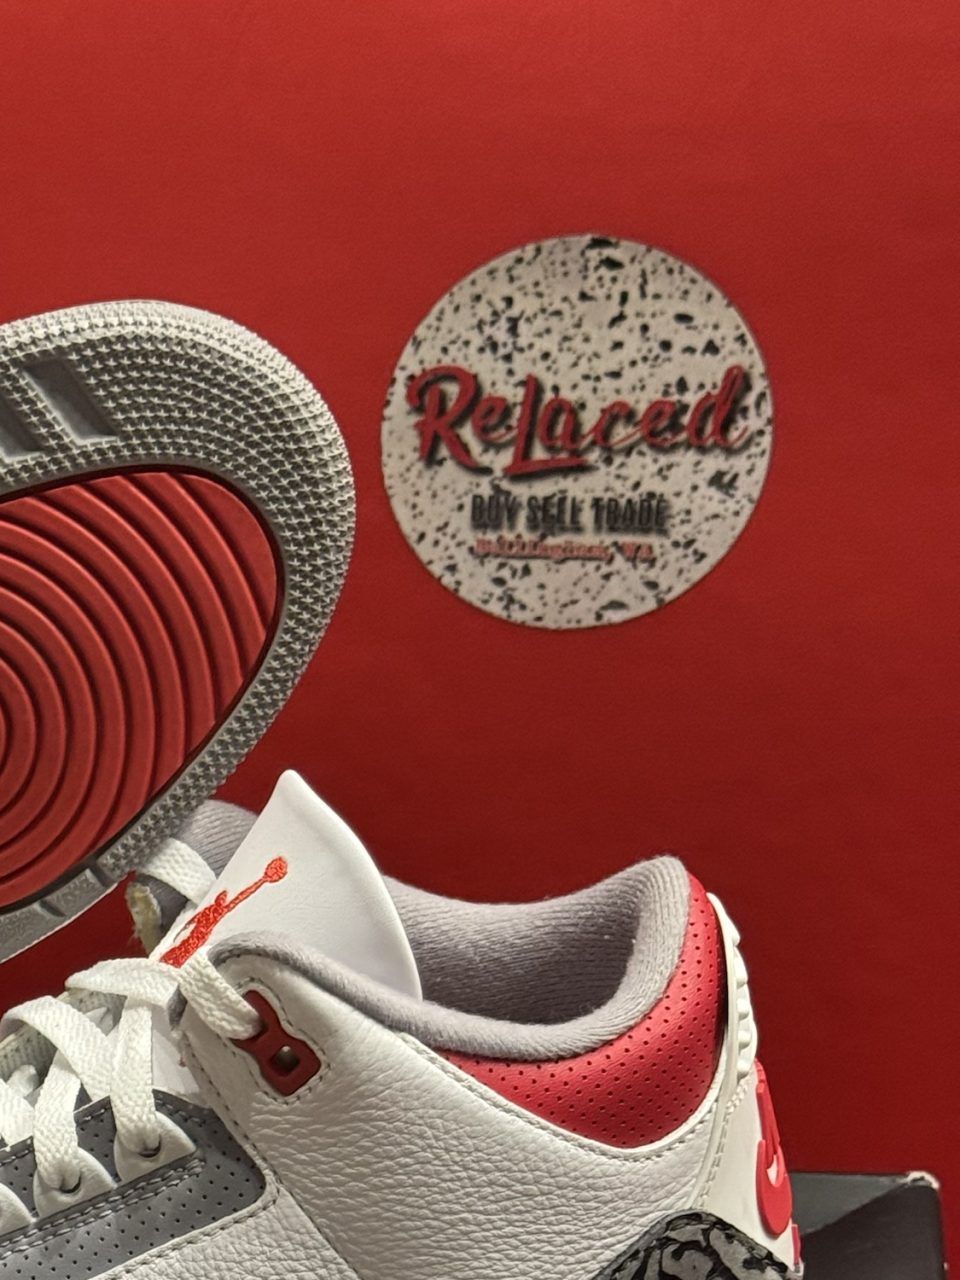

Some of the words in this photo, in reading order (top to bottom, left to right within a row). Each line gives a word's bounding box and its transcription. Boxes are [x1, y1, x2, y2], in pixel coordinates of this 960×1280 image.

[471, 494, 520, 531] BUY
[526, 495, 583, 534] SELL
[592, 496, 669, 535] TRADE
